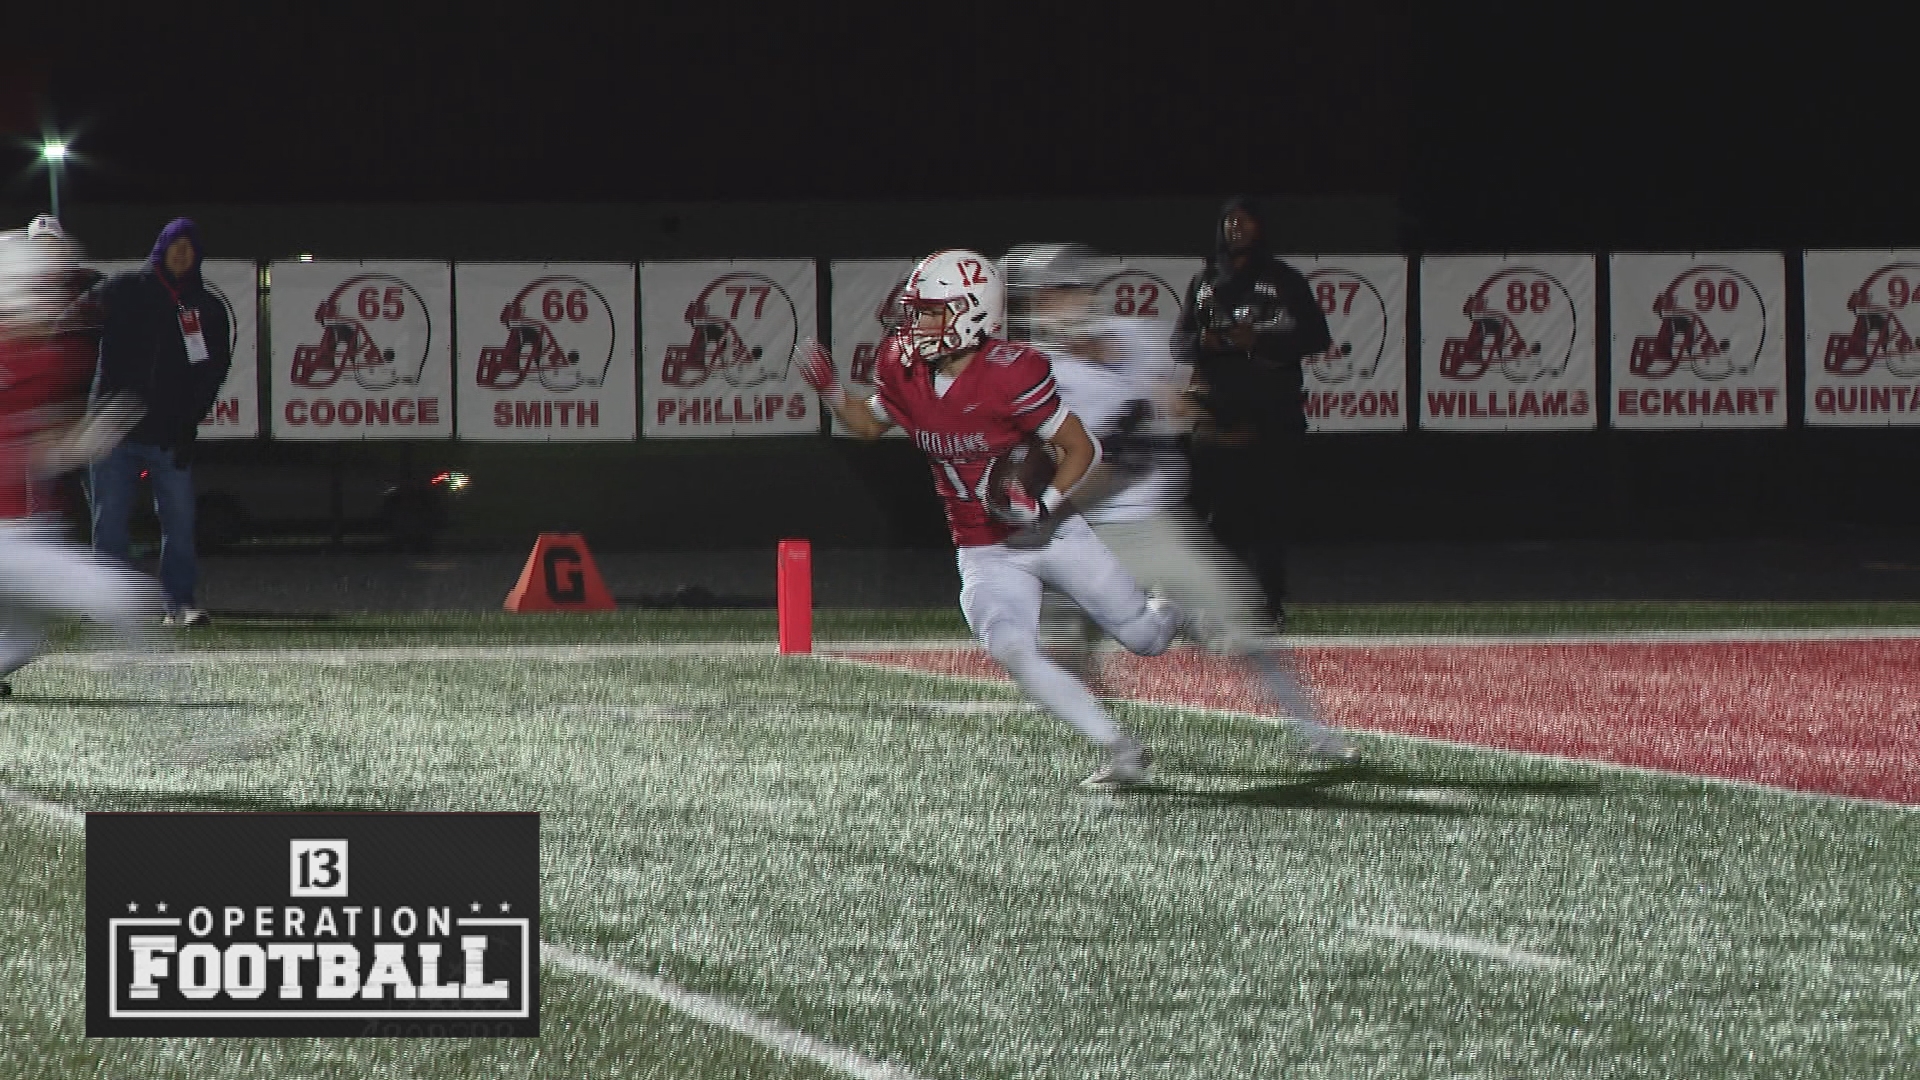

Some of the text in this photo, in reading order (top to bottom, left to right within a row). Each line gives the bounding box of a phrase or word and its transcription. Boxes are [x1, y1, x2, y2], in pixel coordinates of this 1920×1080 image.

[957, 259, 988, 288] 12
[357, 286, 405, 321] 65
[541, 287, 589, 323] 66
[725, 285, 771, 320] 77
[1114, 283, 1160, 316] 82
[1314, 281, 1361, 316] 87
[1505, 280, 1553, 314] 88
[1693, 278, 1740, 313] 90
[284, 397, 439, 427] COONCE
[493, 400, 599, 428] SMITH
[657, 394, 807, 425] PHILLIPS
[1427, 389, 1588, 417] WILLIAMS
[1618, 388, 1779, 415] ECKHART
[915, 429, 989, 457] TROJANS
[544, 546, 585, 603] G
